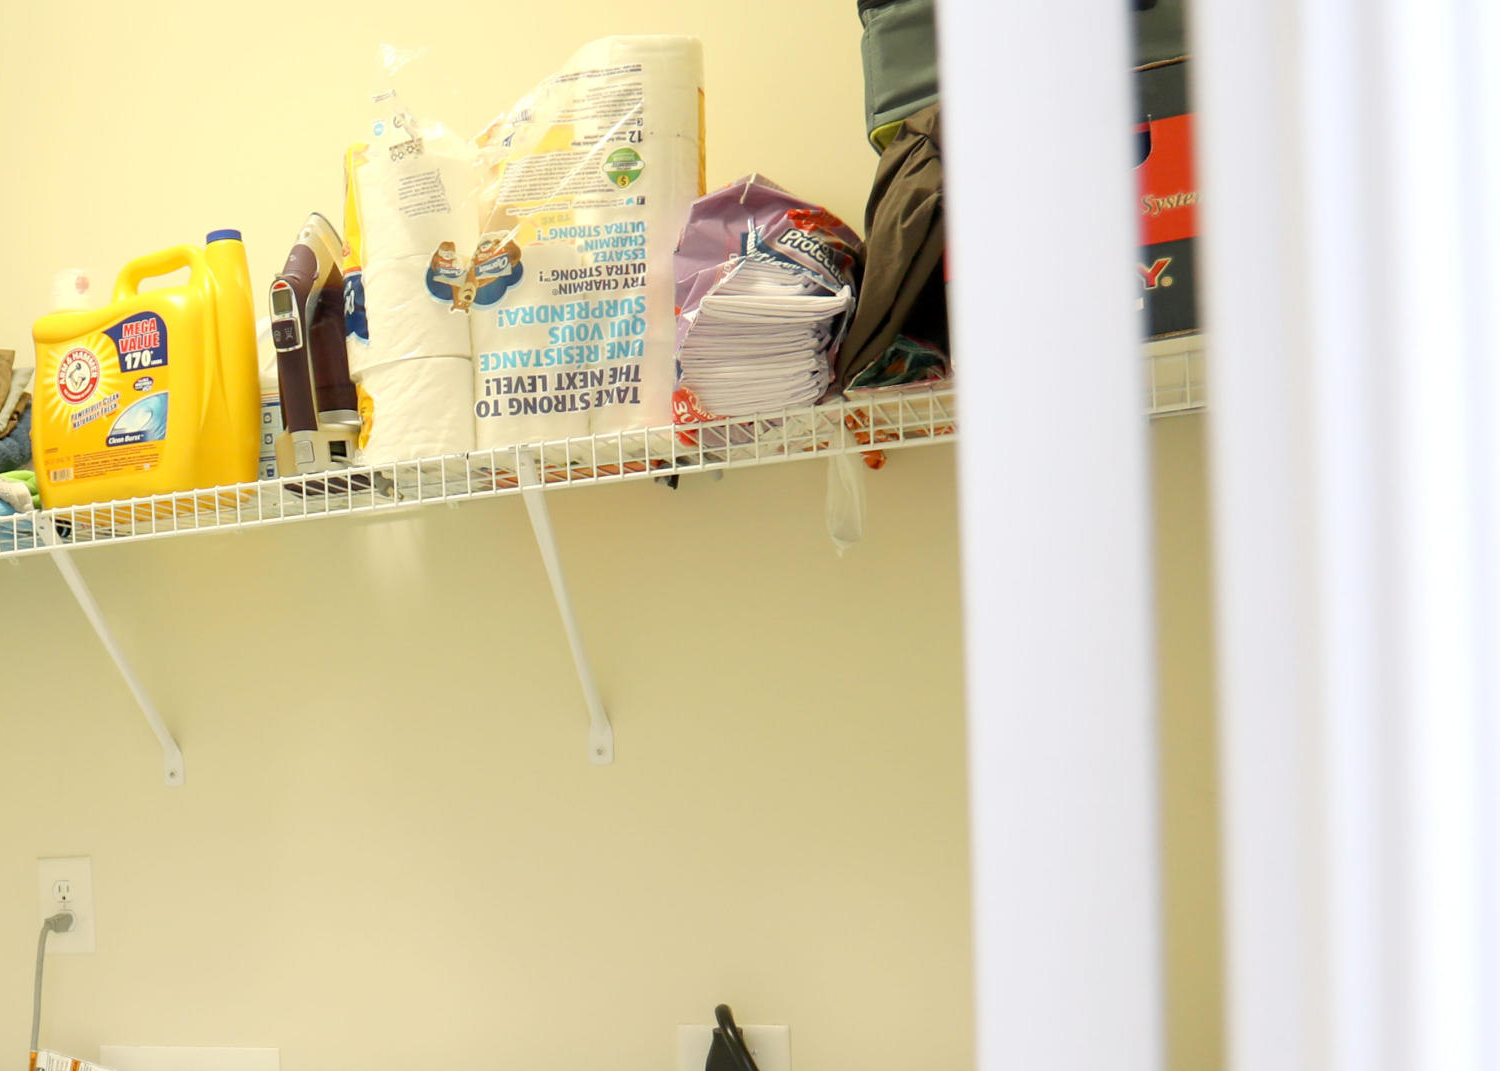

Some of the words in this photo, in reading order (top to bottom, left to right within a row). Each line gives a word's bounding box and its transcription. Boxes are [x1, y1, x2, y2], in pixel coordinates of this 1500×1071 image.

[628, 130, 643, 143] 12
[605, 220, 646, 235] ULTRA
[593, 248, 646, 263] ESSAYEZ
[605, 262, 647, 277] ULTRA
[622, 277, 646, 289] TRY
[498, 295, 646, 328] SURPRENDRA!
[122, 318, 158, 338] MEGA
[548, 322, 604, 345] VOUS
[610, 314, 646, 338] QUI
[118, 332, 161, 353] VALUE
[606, 339, 644, 360] UNE
[72, 351, 98, 378] HAMMER
[480, 344, 599, 371] RÉSISTANCE
[485, 374, 548, 396] LEVEL!
[555, 369, 604, 391] NEXT
[608, 364, 642, 386] THE
[509, 392, 591, 416] STRONG
[594, 386, 641, 408] TAKE
[476, 399, 502, 418] TO
[108, 436, 124, 444] Clean
